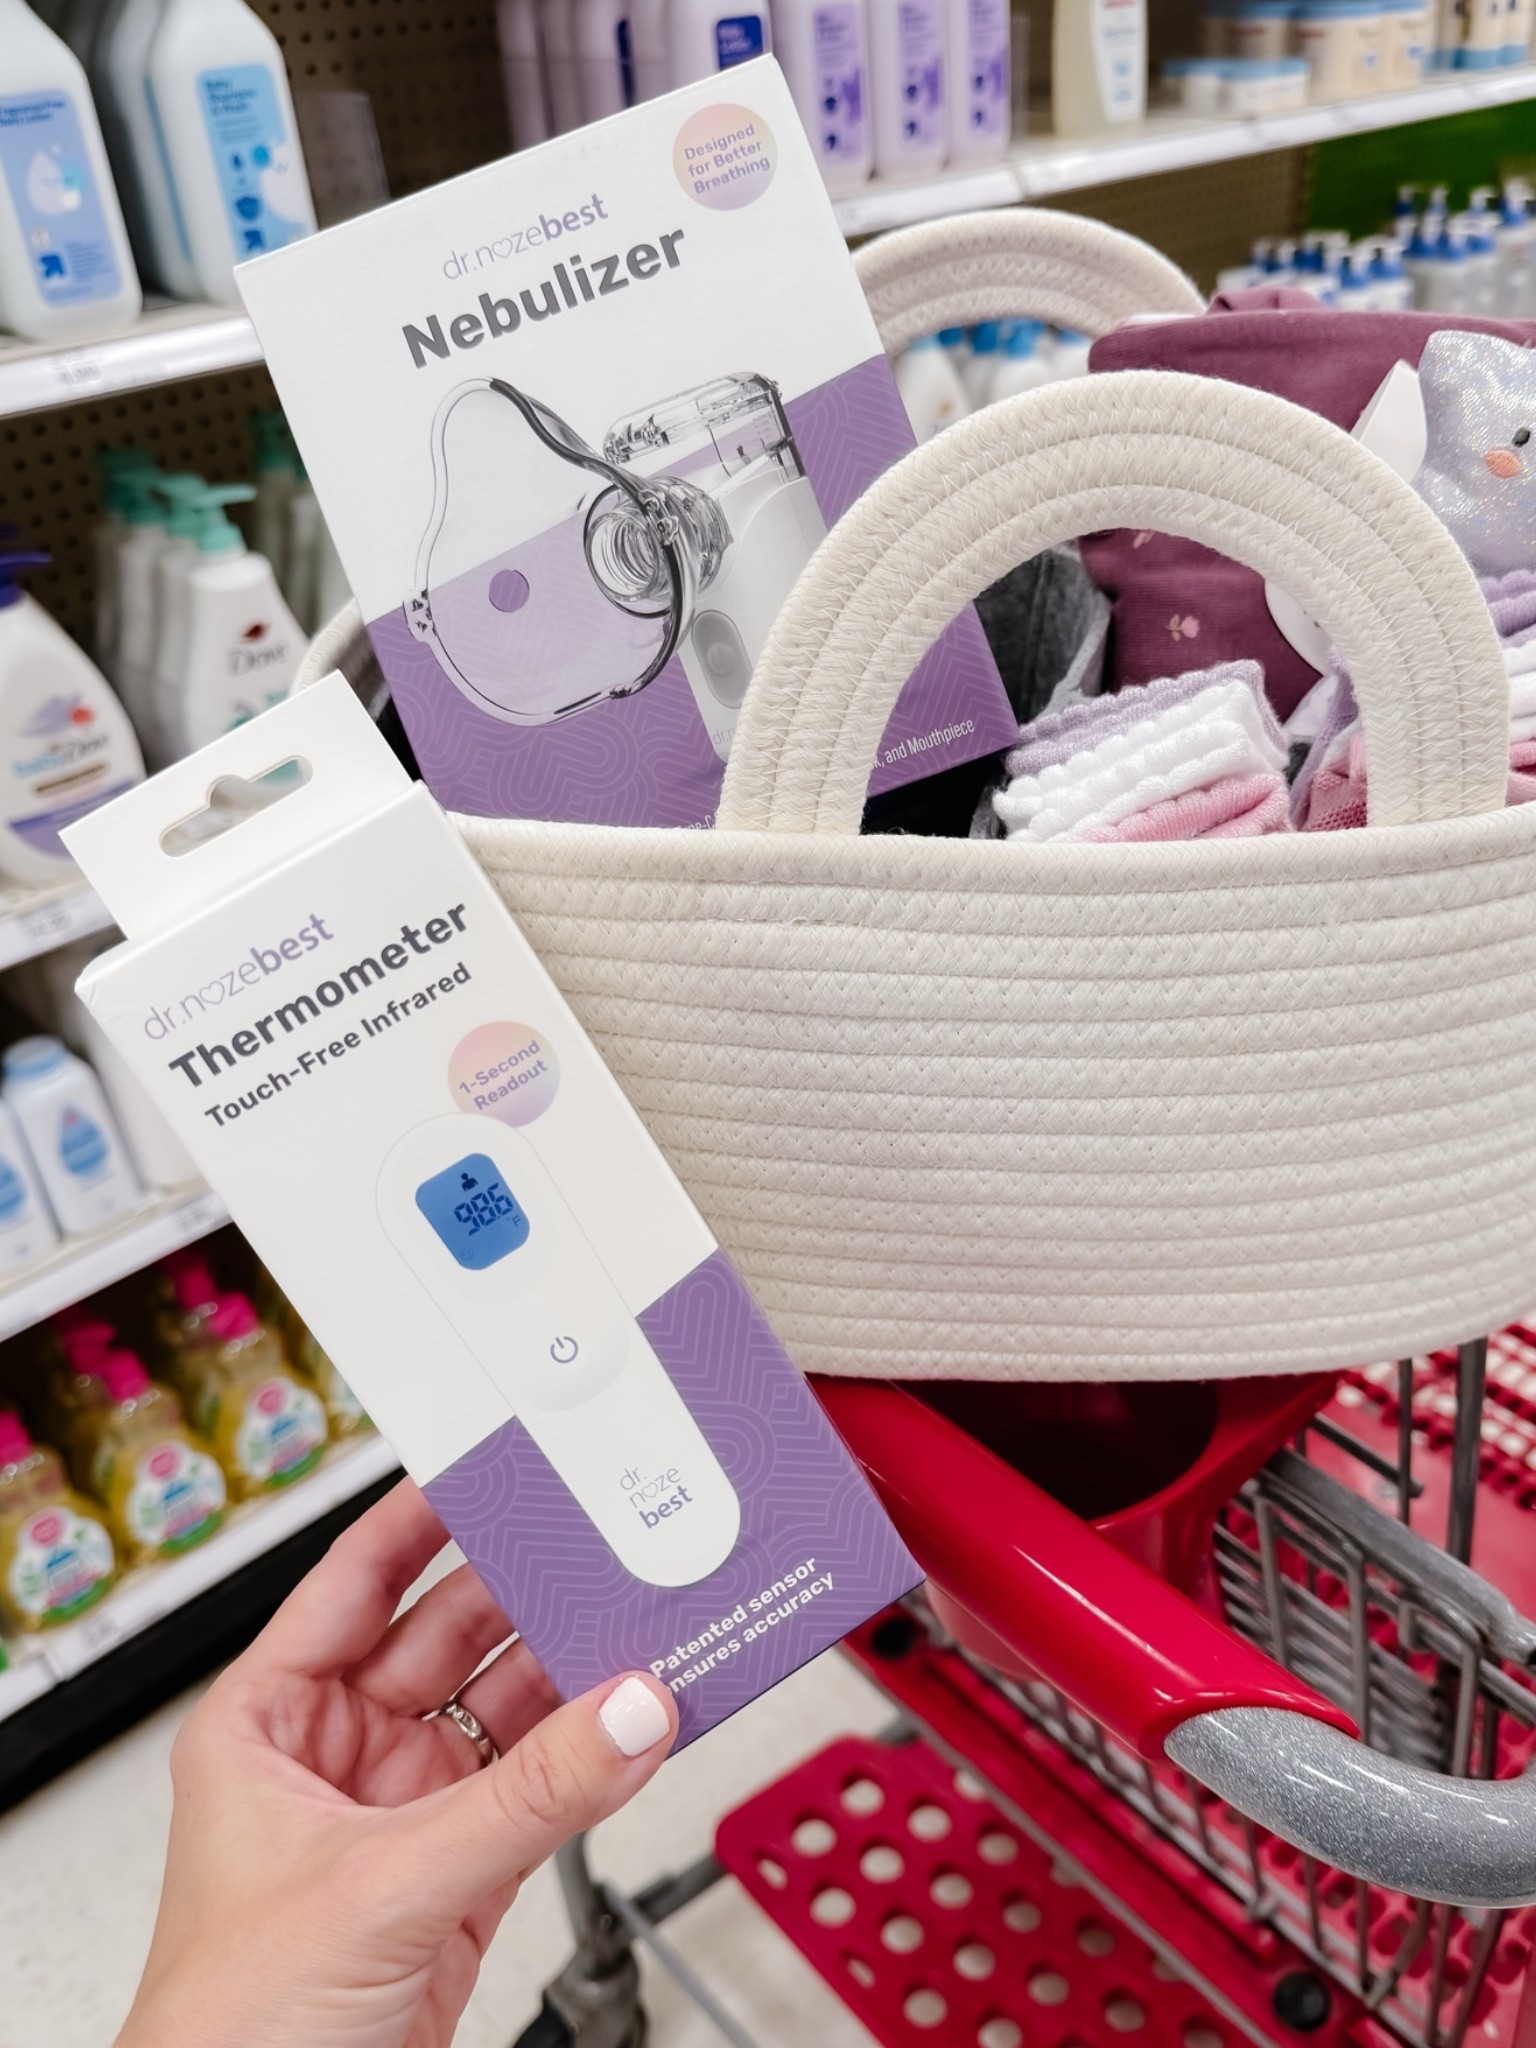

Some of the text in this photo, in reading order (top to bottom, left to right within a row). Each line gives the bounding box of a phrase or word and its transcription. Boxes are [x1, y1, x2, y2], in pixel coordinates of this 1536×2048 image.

[684, 123, 755, 161] Designed
[688, 141, 762, 178] for Better
[693, 157, 770, 195] Breathing
[402, 229, 685, 369] Nebulizer
[884, 743, 908, 765] and
[907, 719, 976, 755] Mouthpiece
[168, 903, 468, 1088] Thermometer
[204, 962, 473, 1128] Touch-Free Infrared
[459, 1039, 541, 1095] 1-Second
[473, 1059, 549, 1111] Readout
[638, 1485, 694, 1530] best
[650, 1557, 816, 1679] Patented sensor
[668, 1571, 835, 1694] nsures accuracy
